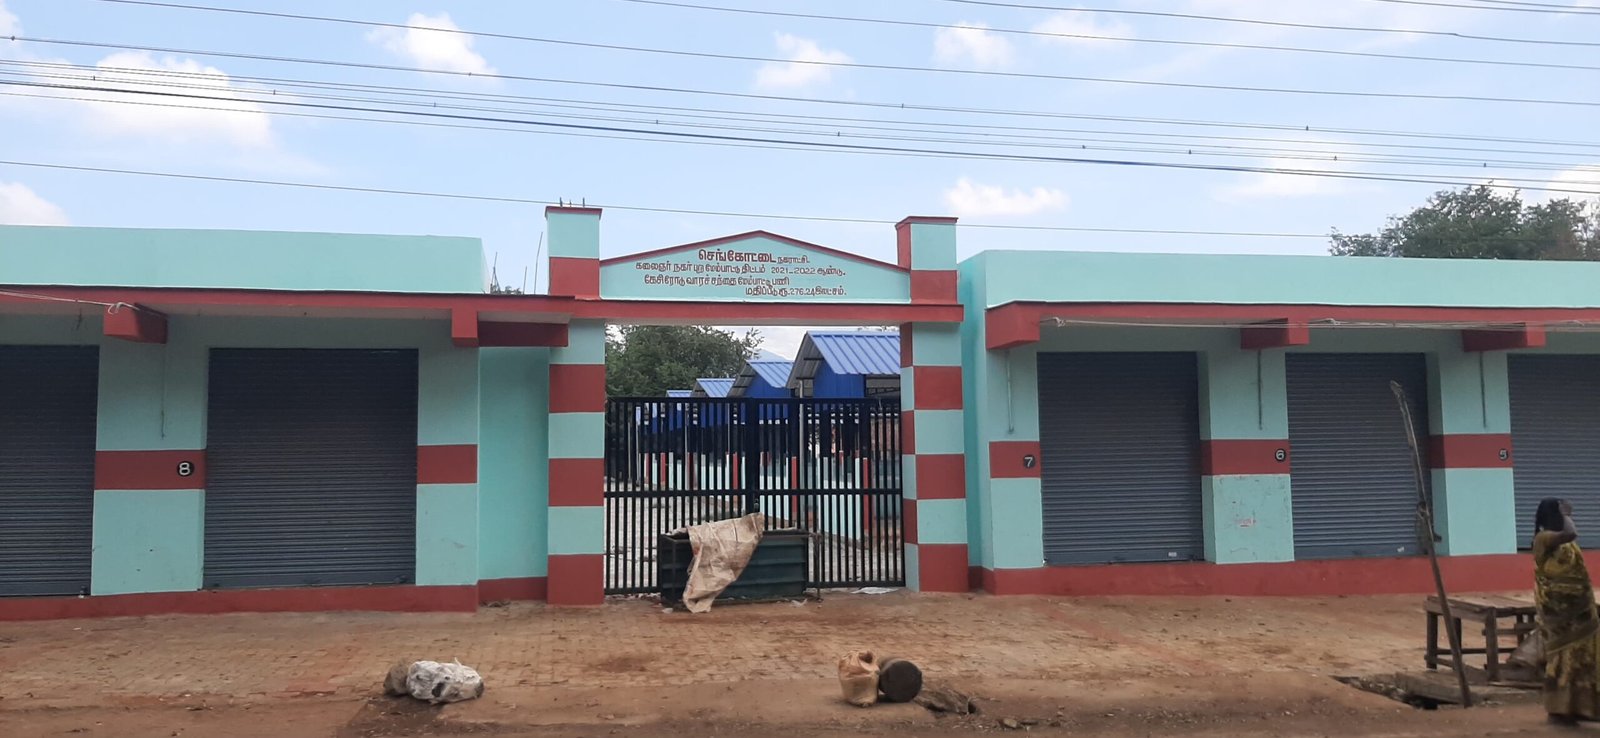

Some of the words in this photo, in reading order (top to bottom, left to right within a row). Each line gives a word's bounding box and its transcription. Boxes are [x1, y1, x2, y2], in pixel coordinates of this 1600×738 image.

[698, 248, 776, 263] செங்கோட்டை
[635, 260, 671, 272] கலைஞர்
[1275, 449, 1285, 460] 6
[1499, 449, 1507, 460] 5
[1024, 456, 1034, 468] 7
[179, 461, 191, 476] 8
